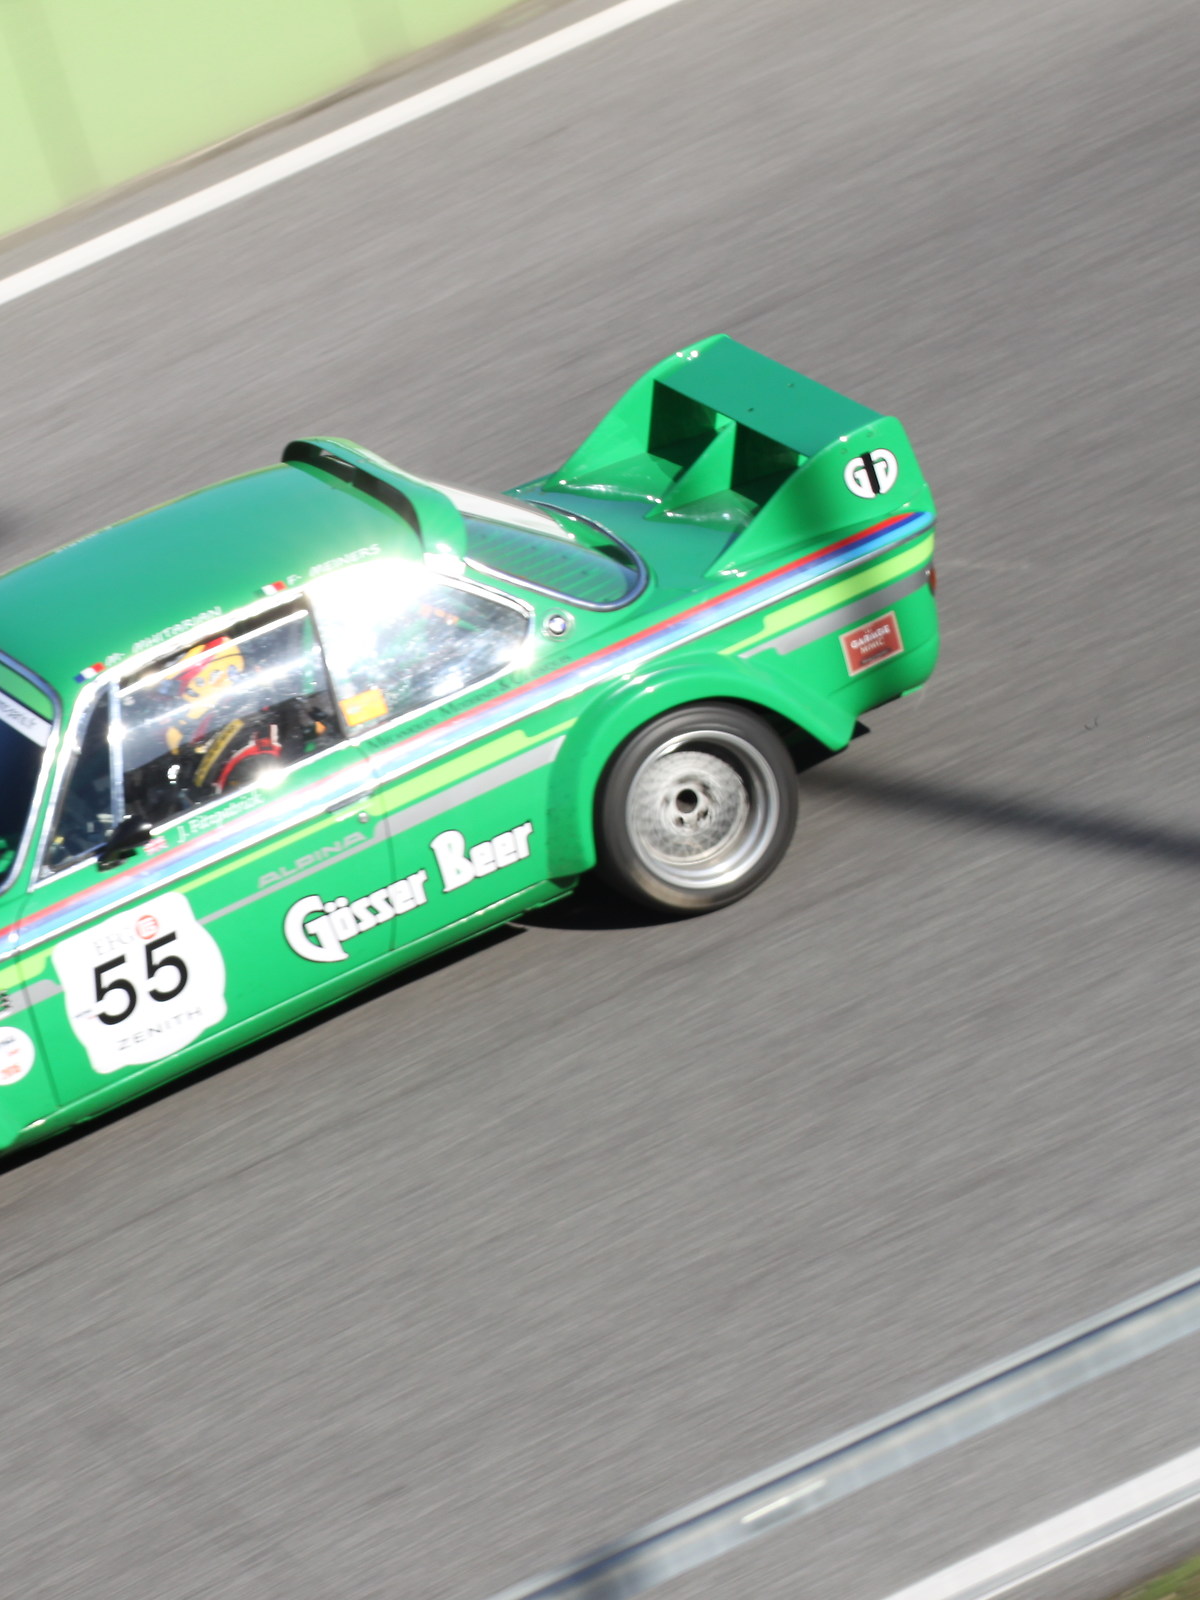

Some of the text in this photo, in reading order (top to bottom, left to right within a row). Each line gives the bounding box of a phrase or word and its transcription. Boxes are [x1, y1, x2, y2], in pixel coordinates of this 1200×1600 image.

[257, 832, 369, 889] ALPINA
[283, 820, 534, 963] Gösser Beer
[94, 931, 189, 1026] 55
[117, 1007, 203, 1051] ZENITH
